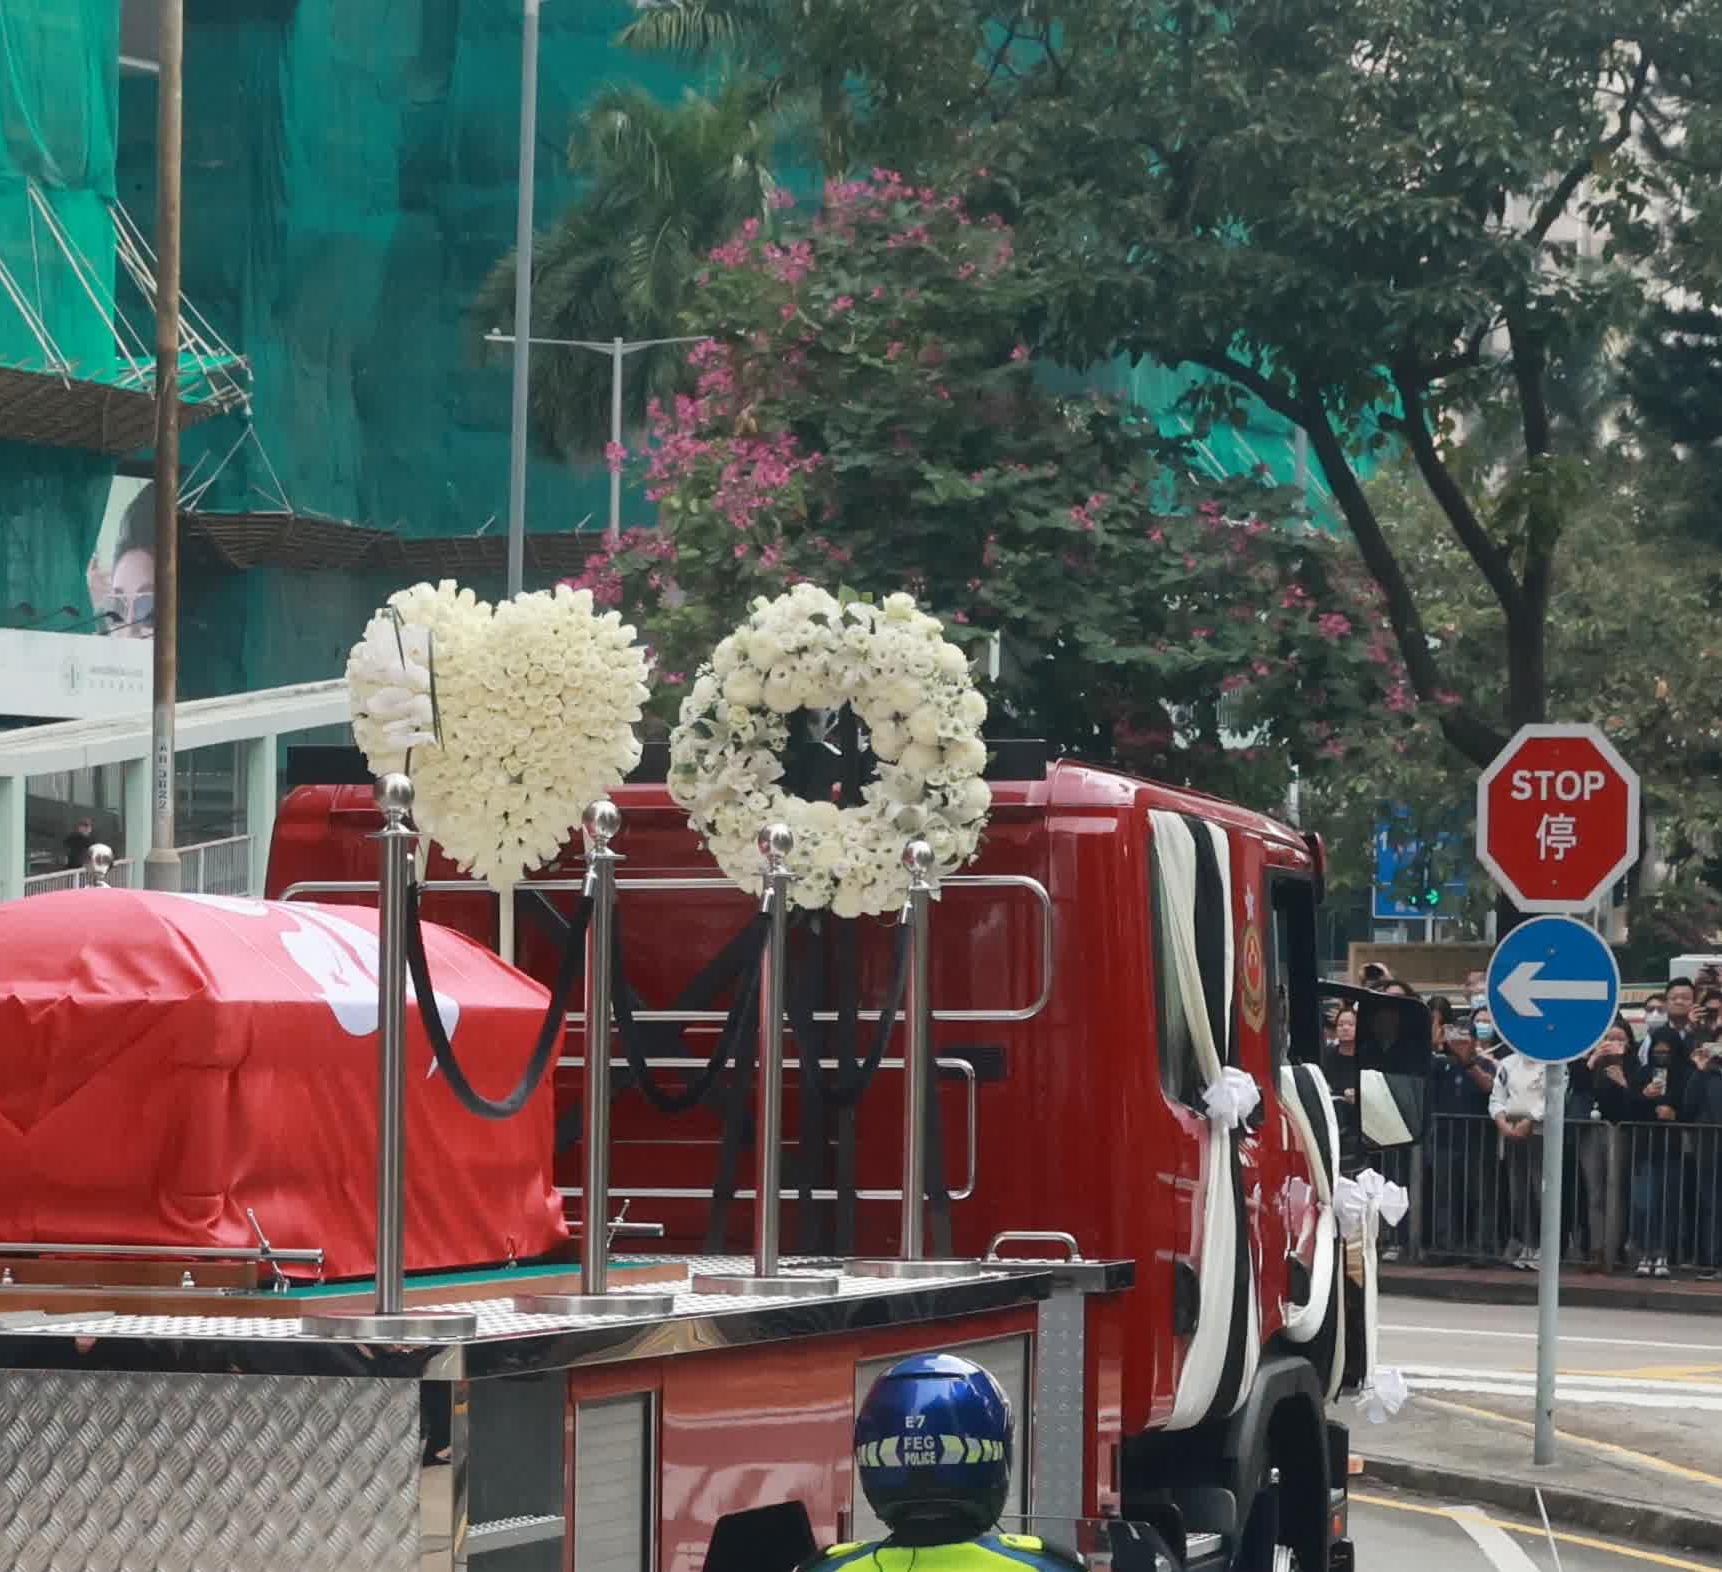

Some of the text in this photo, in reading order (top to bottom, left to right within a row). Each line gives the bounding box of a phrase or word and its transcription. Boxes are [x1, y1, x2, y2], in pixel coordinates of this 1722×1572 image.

[1510, 769, 1606, 801] STOP
[1535, 812, 1577, 861] 停
[904, 1415, 926, 1429] E7
[903, 1436, 935, 1450] FEG
[904, 1451, 937, 1465] POLICE
